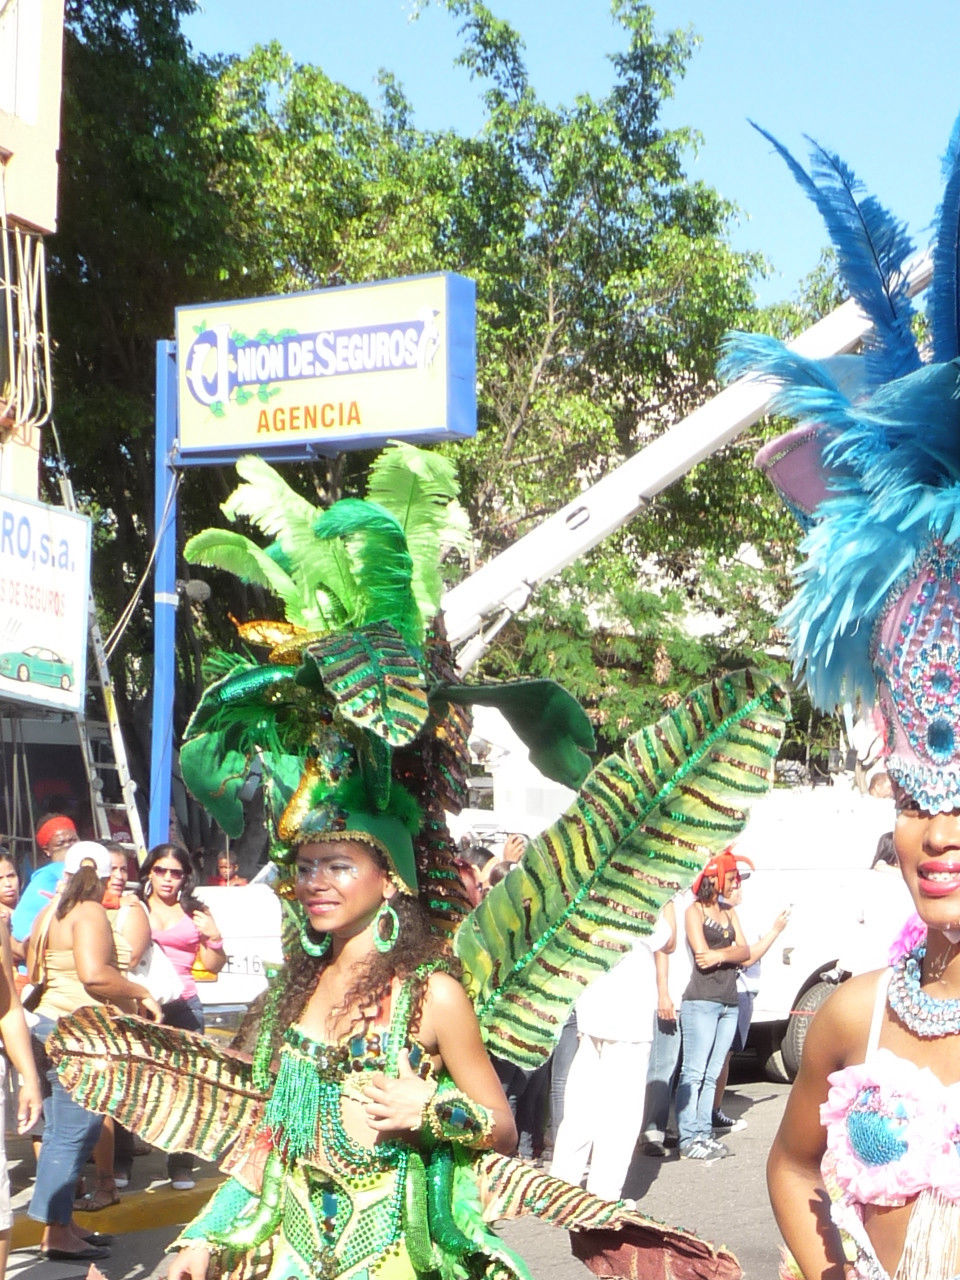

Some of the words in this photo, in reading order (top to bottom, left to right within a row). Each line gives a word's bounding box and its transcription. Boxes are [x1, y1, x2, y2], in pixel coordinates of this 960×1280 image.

[193, 323, 283, 404] UNION
[288, 340, 314, 378] DE
[314, 331, 419, 377] SEGUROS
[256, 400, 361, 434] AGENCIA
[23, 583, 66, 618] SEGUROS
